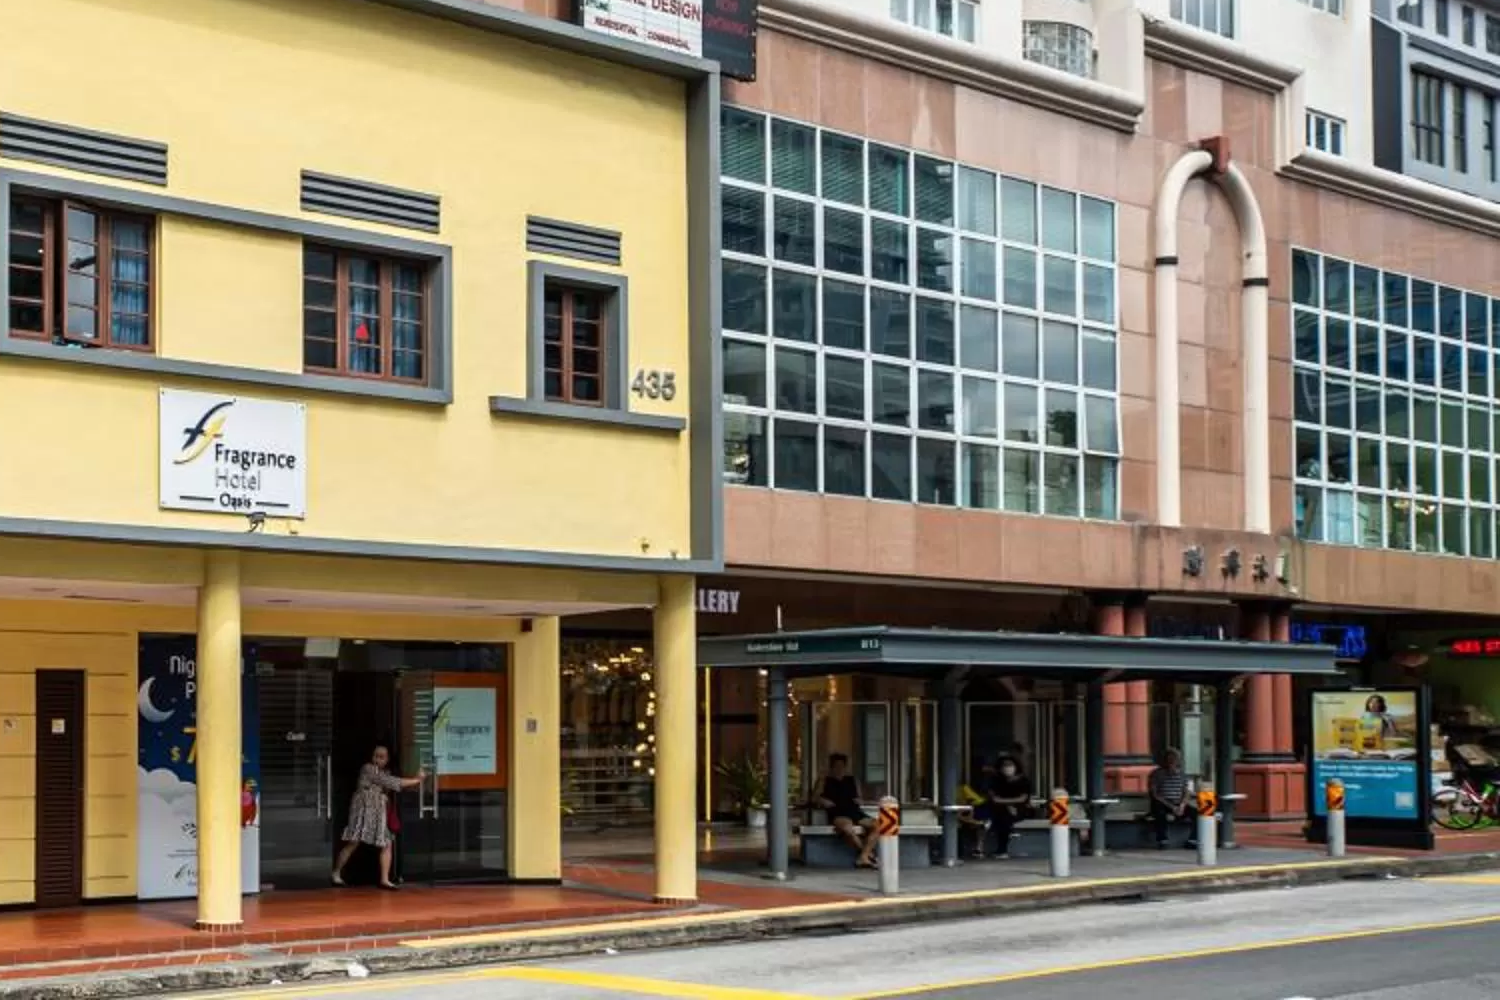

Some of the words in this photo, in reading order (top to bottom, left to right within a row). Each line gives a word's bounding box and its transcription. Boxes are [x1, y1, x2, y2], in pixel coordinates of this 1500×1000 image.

[631, 368, 677, 401] 435
[214, 443, 297, 471] Fragrance
[214, 468, 261, 491] Hotel
[697, 588, 740, 613] LERY
